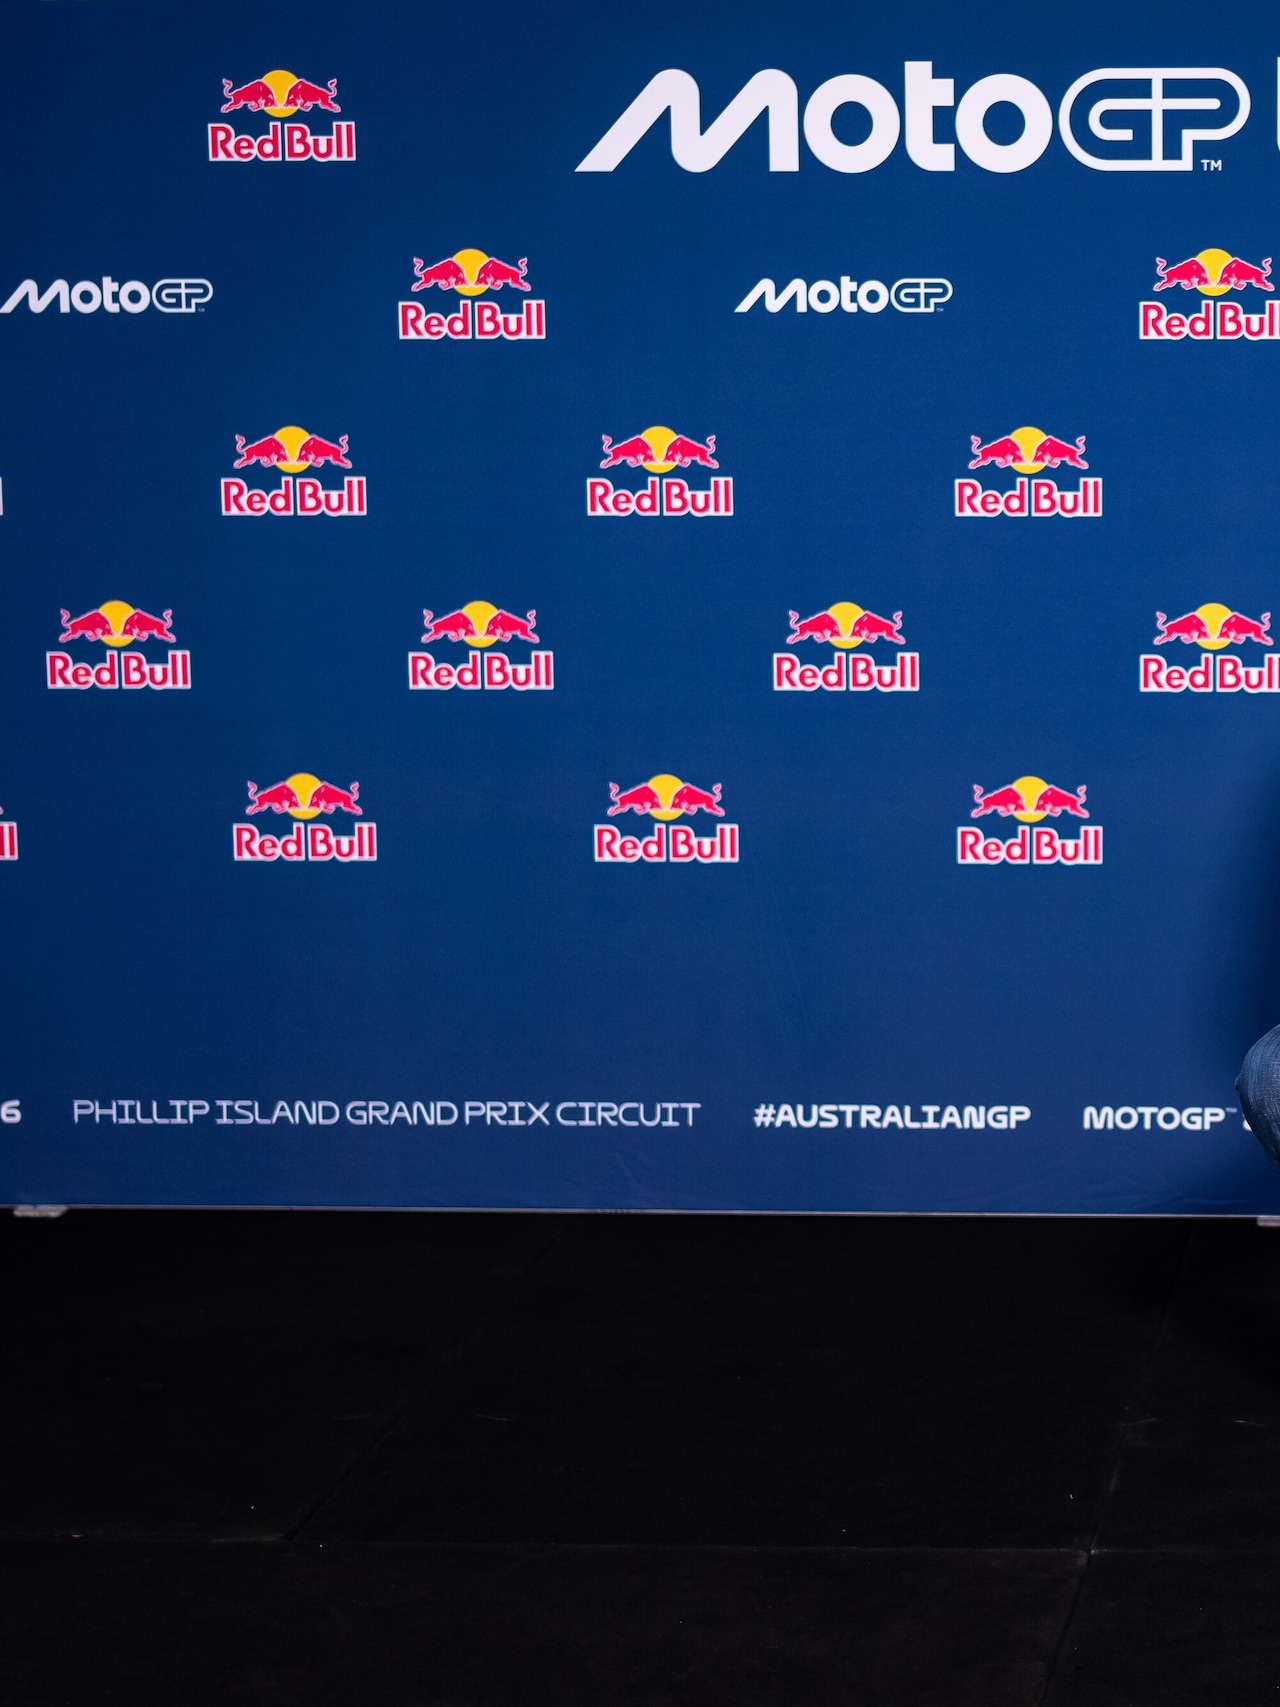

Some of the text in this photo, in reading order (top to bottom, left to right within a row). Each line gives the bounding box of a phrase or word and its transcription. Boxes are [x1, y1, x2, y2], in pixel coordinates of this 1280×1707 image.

[575, 61, 1251, 173] MotoGP
[208, 122, 357, 162] Red Bull
[0, 276, 214, 314] MotoGP
[734, 276, 954, 313] MotoGP
[398, 300, 546, 341] Red Bull
[1140, 300, 1214, 340] Red
[221, 476, 367, 516] Red Bull
[587, 477, 734, 517] Red Bull
[955, 478, 1103, 518] Red Bull
[46, 650, 191, 690] Red Bull
[408, 651, 554, 690] Red Bull
[773, 652, 919, 692] Red Bull
[1140, 653, 1213, 692] Red
[0, 821, 18, 861] ll
[233, 822, 378, 862] Red Bull
[594, 824, 739, 863] Red Bull
[957, 826, 1104, 865] Red Bull
[73, 1100, 702, 1127] PHILLIP ISLAND GRAND PRIX CIRCUIT
[753, 1104, 1032, 1130] #AUSTRALIANGP
